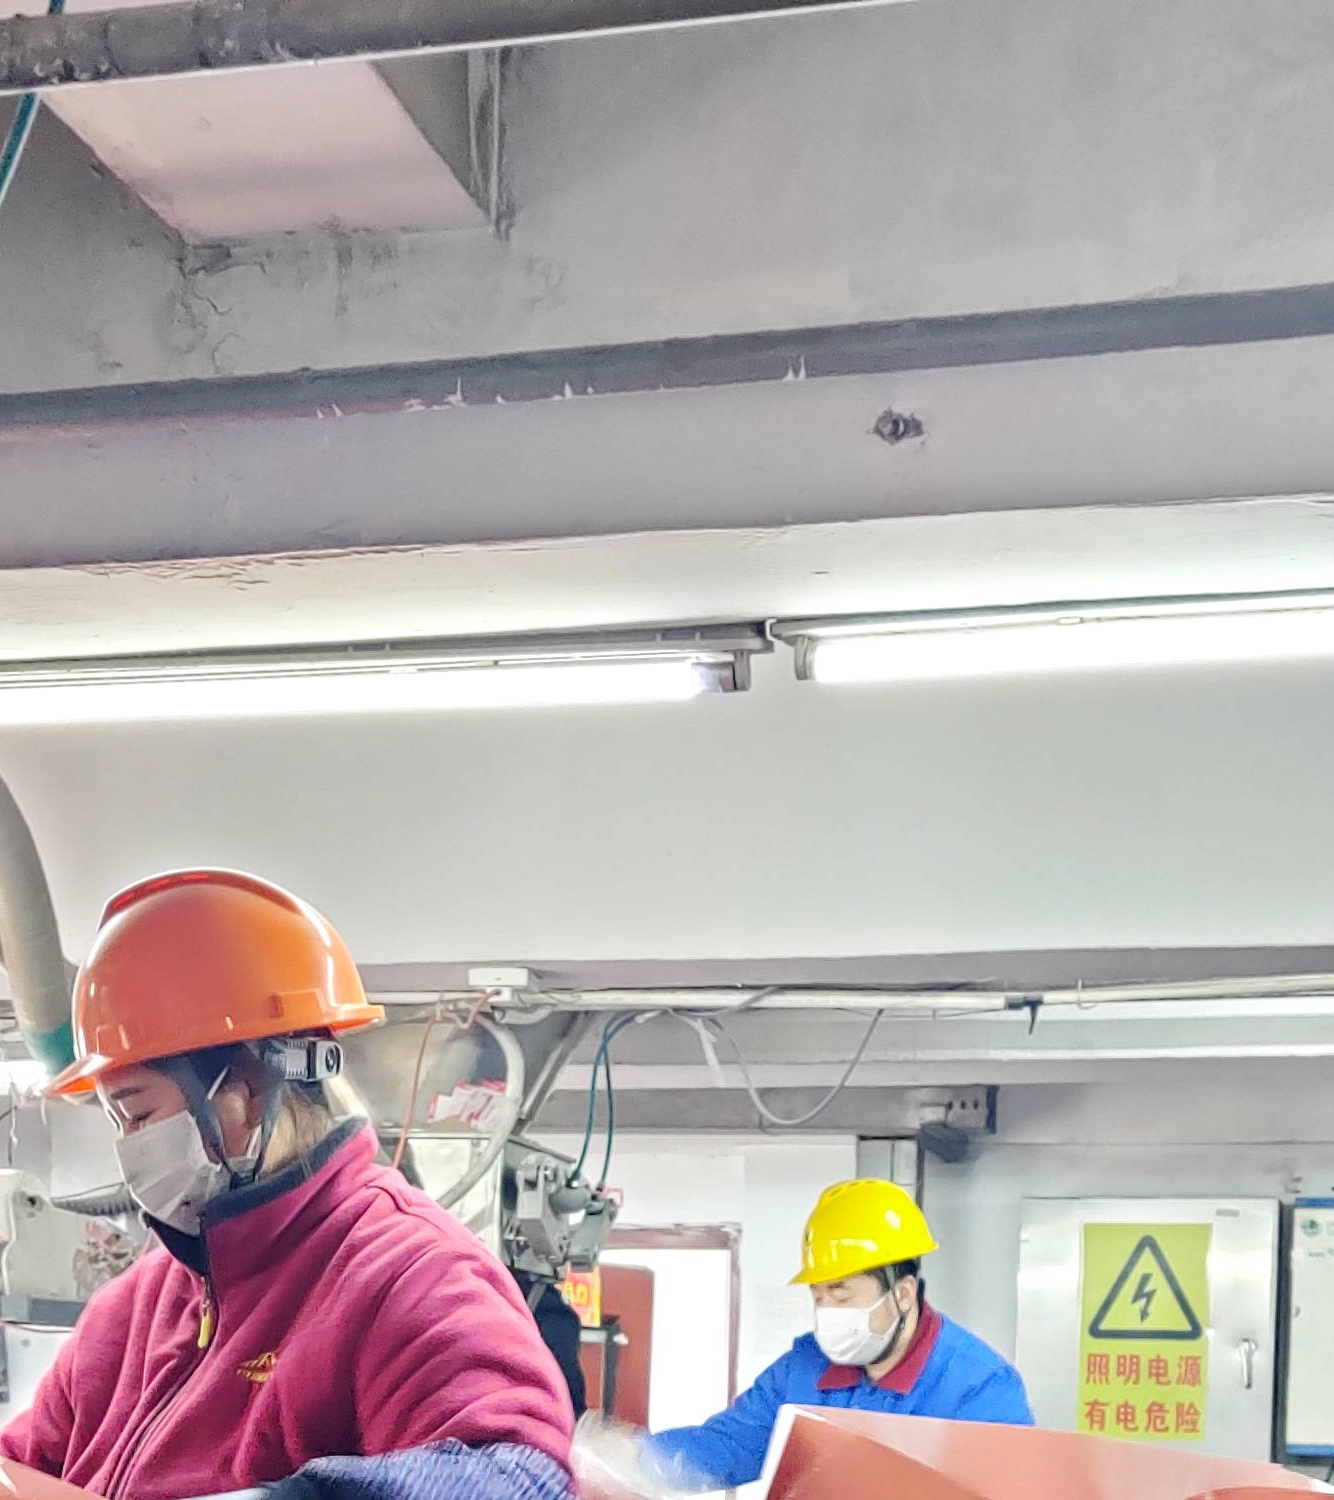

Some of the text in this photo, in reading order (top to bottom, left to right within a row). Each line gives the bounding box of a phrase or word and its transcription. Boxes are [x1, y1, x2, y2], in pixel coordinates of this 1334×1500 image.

[1084, 1352, 1203, 1387] 照明电源
[1083, 1400, 1203, 1434] 有电危险
